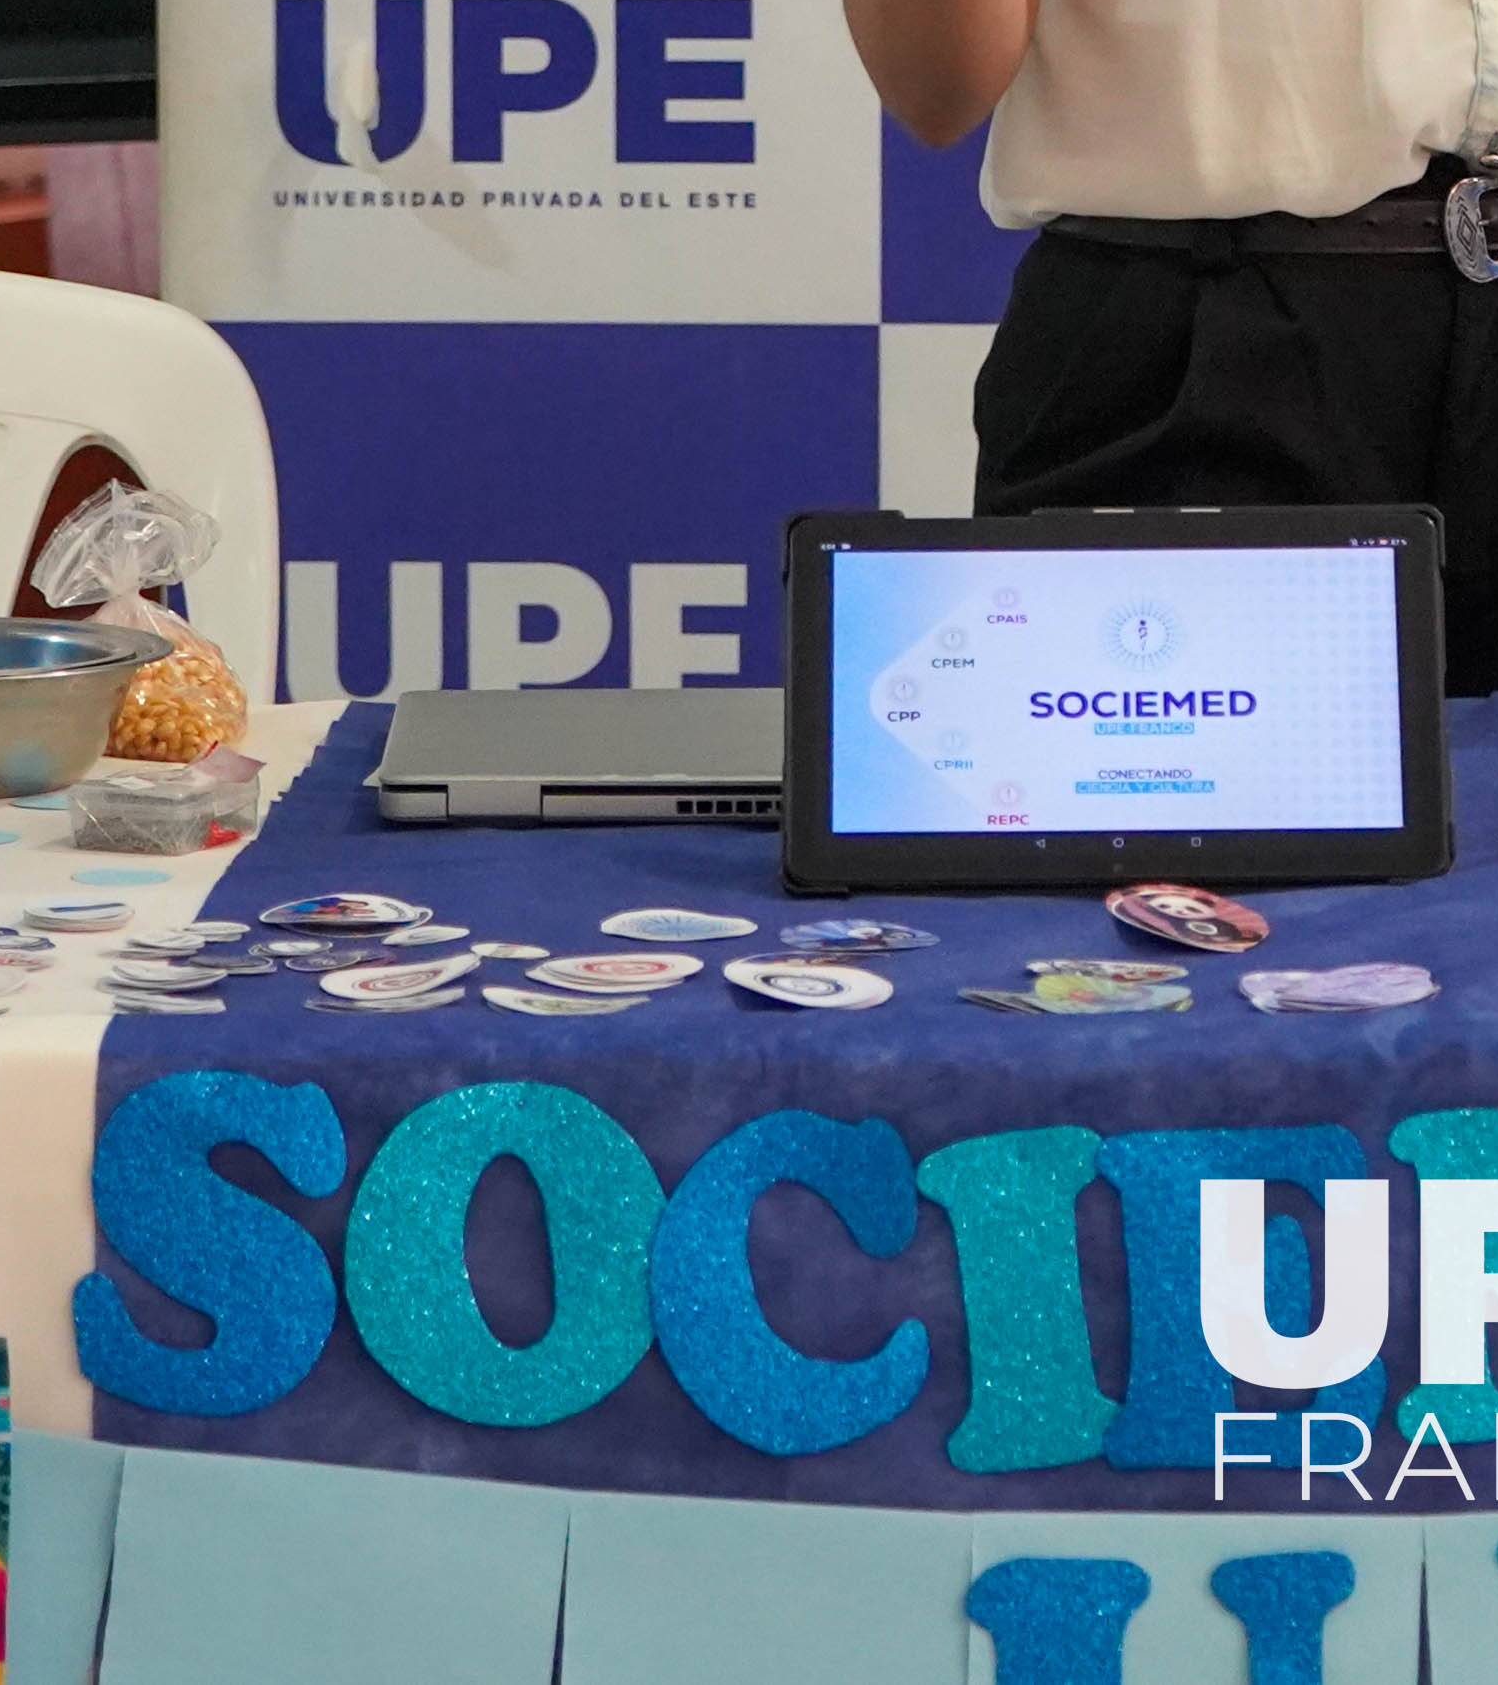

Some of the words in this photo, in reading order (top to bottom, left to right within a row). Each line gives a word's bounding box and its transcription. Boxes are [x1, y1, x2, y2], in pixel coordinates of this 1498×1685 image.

[273, 190, 466, 209] UNIVERSIDAD
[482, 191, 604, 208] PRIVADA
[620, 191, 671, 208] DEL
[689, 191, 757, 208] ESTE
[986, 614, 1029, 625] CPAIS
[284, 560, 748, 703] UPE
[931, 658, 975, 669] CPEM
[1029, 689, 1257, 719] SOCIEMED
[886, 710, 922, 723] CPP
[1097, 769, 1193, 780] CONECTANDO
[986, 814, 1030, 826] REPC
